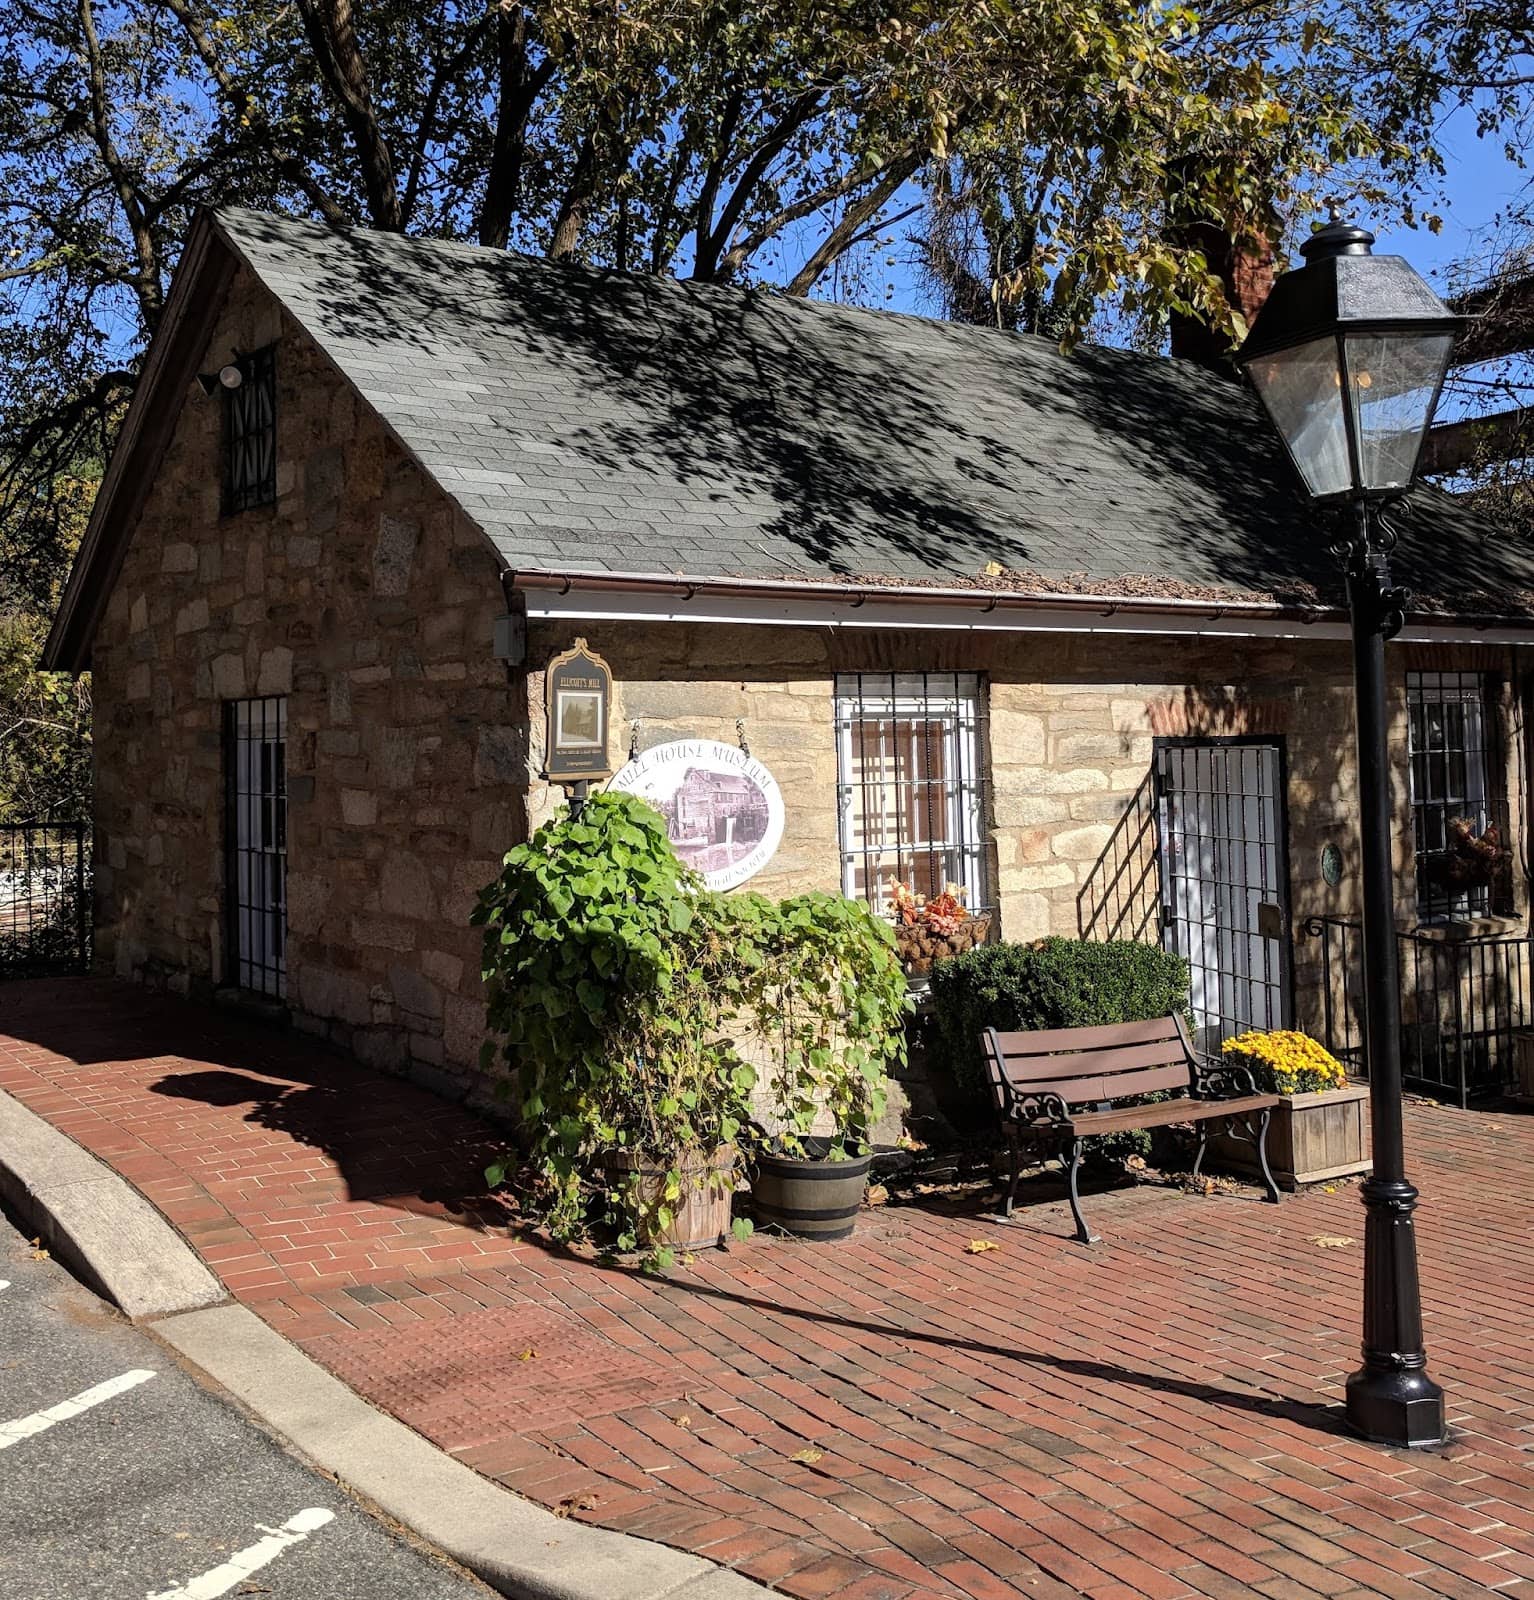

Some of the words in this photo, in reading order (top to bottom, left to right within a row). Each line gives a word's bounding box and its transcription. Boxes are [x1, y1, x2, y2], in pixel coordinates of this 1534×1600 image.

[588, 678, 600, 688] MILL
[617, 761, 649, 789] MILL
[654, 744, 704, 764] HOUSE
[712, 745, 772, 789] MUSEUM
